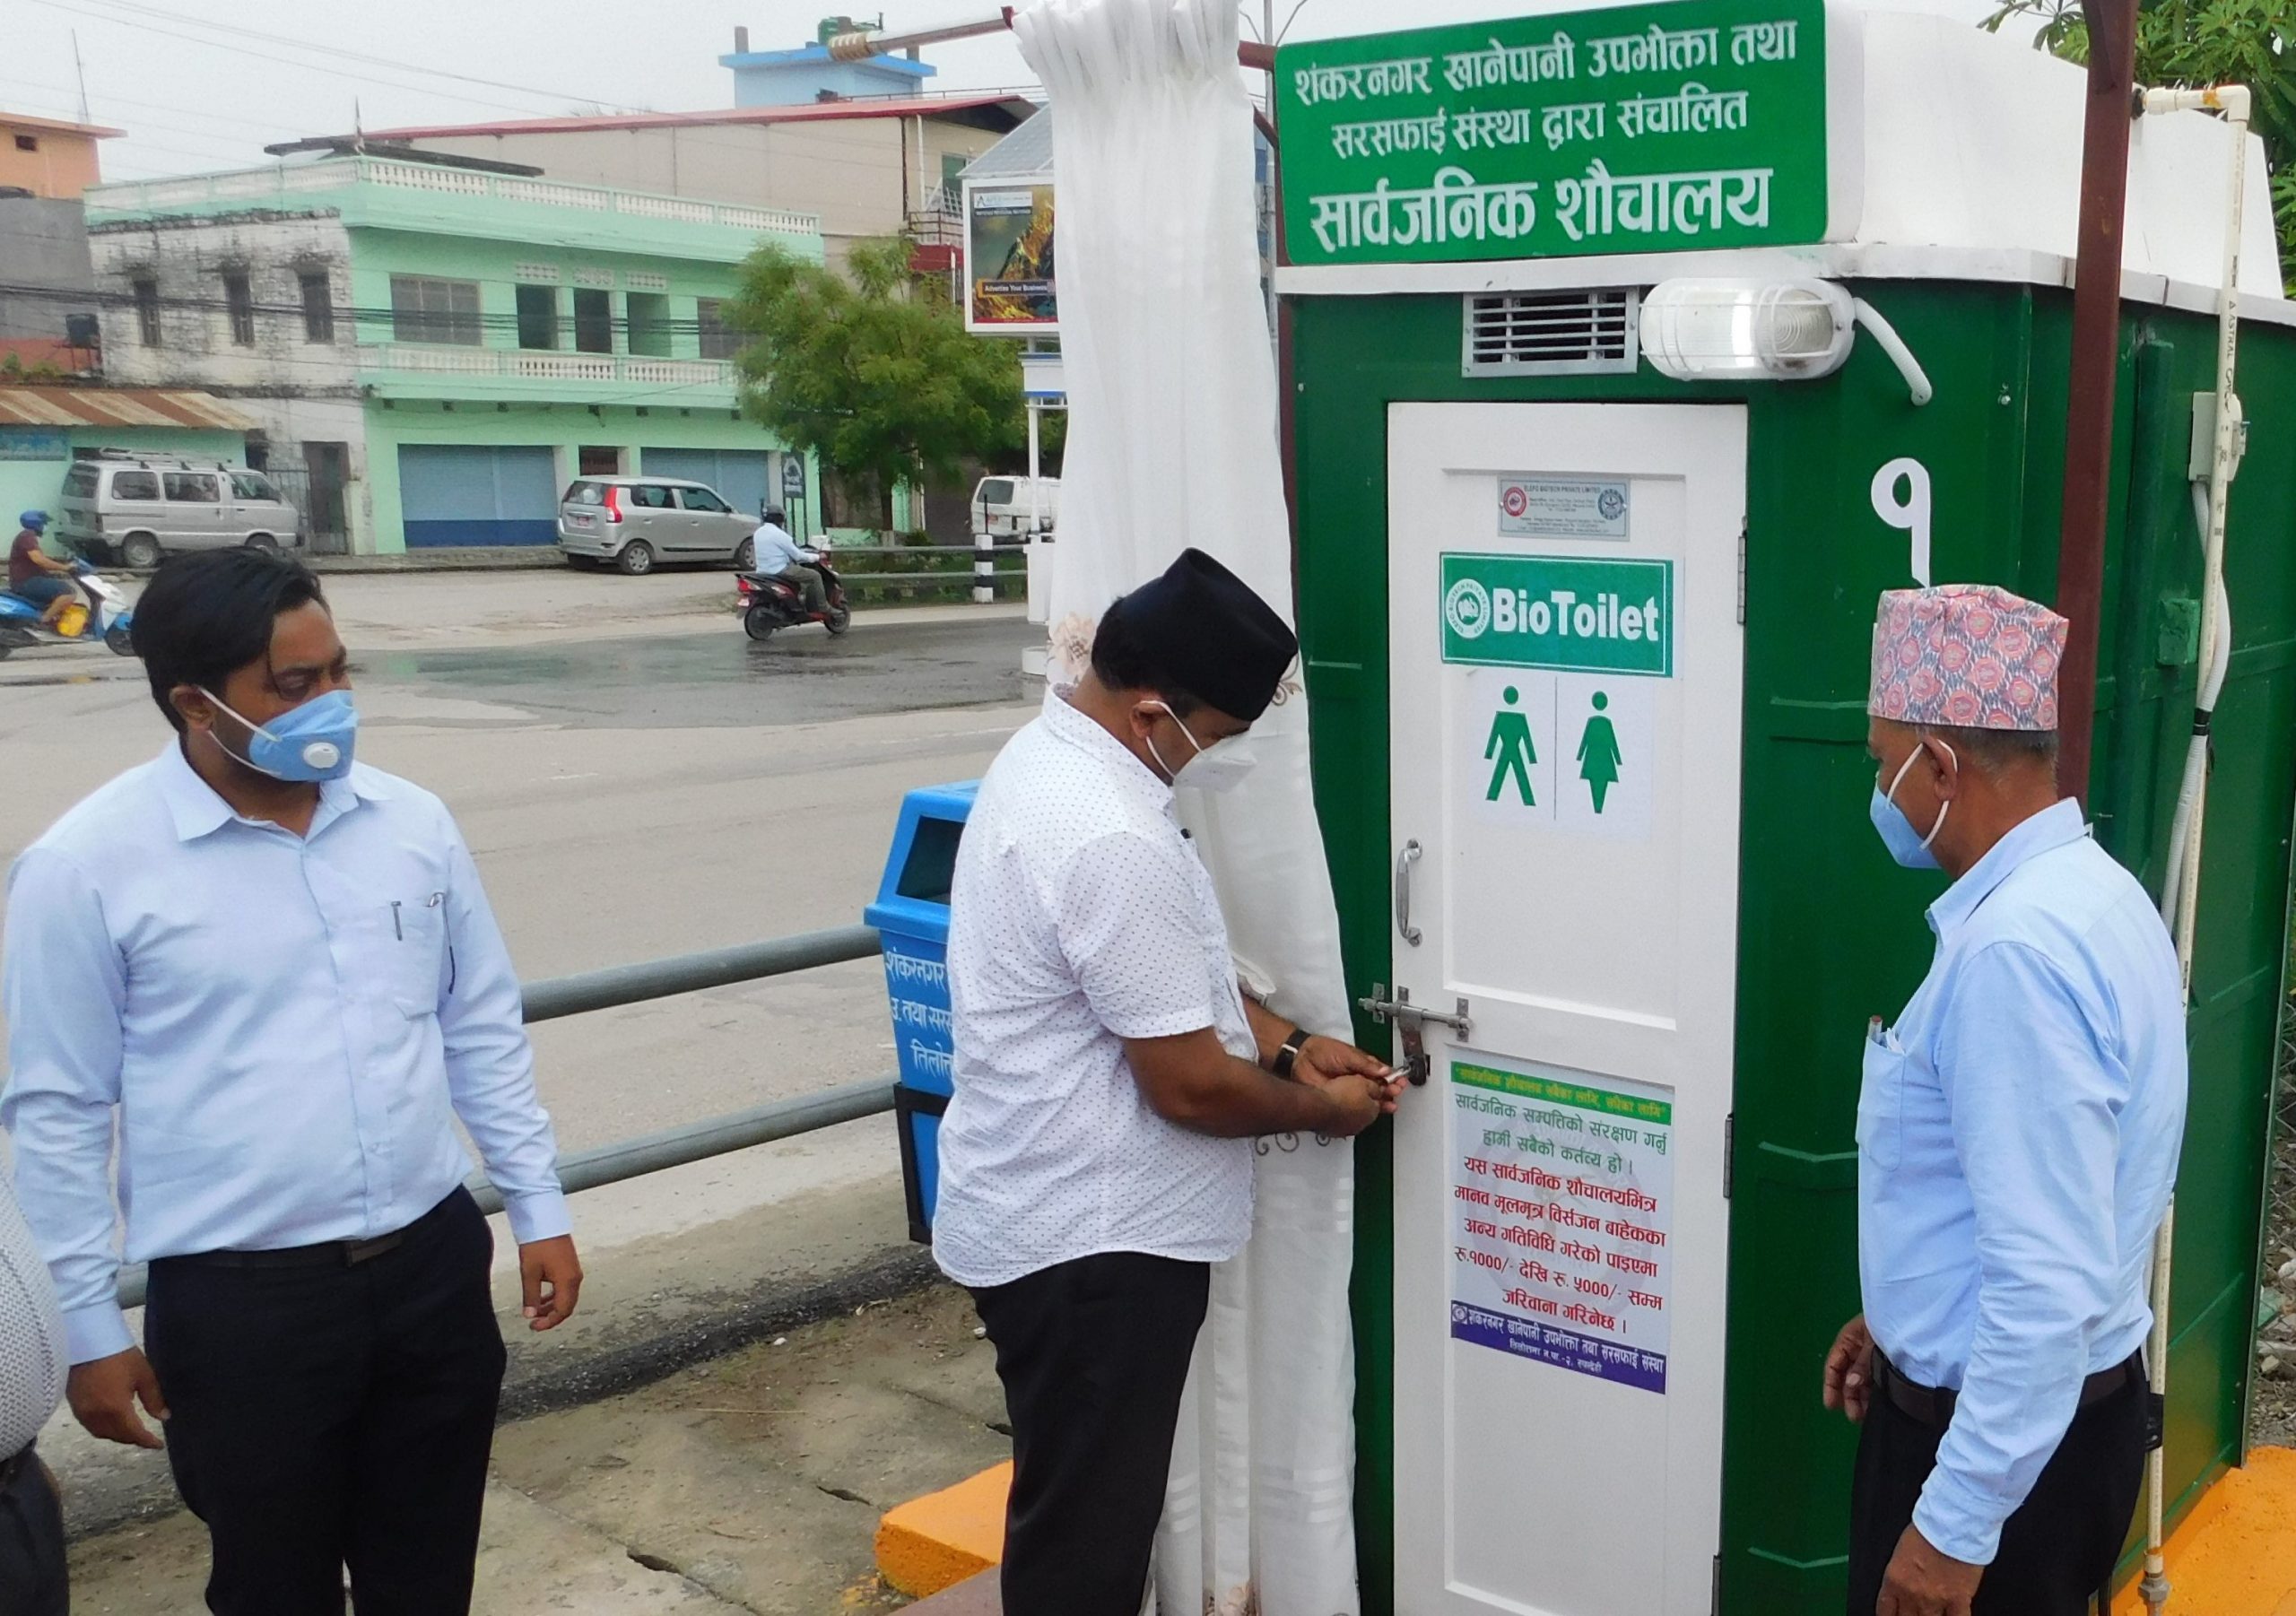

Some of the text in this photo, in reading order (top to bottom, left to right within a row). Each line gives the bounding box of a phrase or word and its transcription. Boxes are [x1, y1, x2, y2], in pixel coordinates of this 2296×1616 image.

[1295, 20, 1797, 106] शंकरनगर खानेपानी उपभोक्ता तथा
[1332, 82, 1748, 160] सरसफाई संस्था द्वारा संचालित
[1309, 159, 1774, 253] सार्वजनिक शौचालय
[1492, 587, 1658, 641] BioToilet
[885, 947, 947, 993] शंकरनगर
[902, 999, 927, 1031] तथा
[1455, 1093, 1517, 1118] सार्वजनिक
[1589, 1120, 1637, 1143] संरक्षण
[1518, 1134, 1554, 1157] सबैको
[1561, 1145, 1601, 1168] कर्तव्य
[1454, 1185, 1490, 1205] मानव
[1464, 1156, 1657, 1212] यस सार्वजनिक शौचालयभित्र
[1464, 1218, 1657, 1278] अन्य गतिविधि गरेको पाइएमा
[1502, 1289, 1558, 1316] जरिवाना
[1518, 1259, 1549, 1283] देखि
[1628, 1290, 1663, 1310] सम्म
